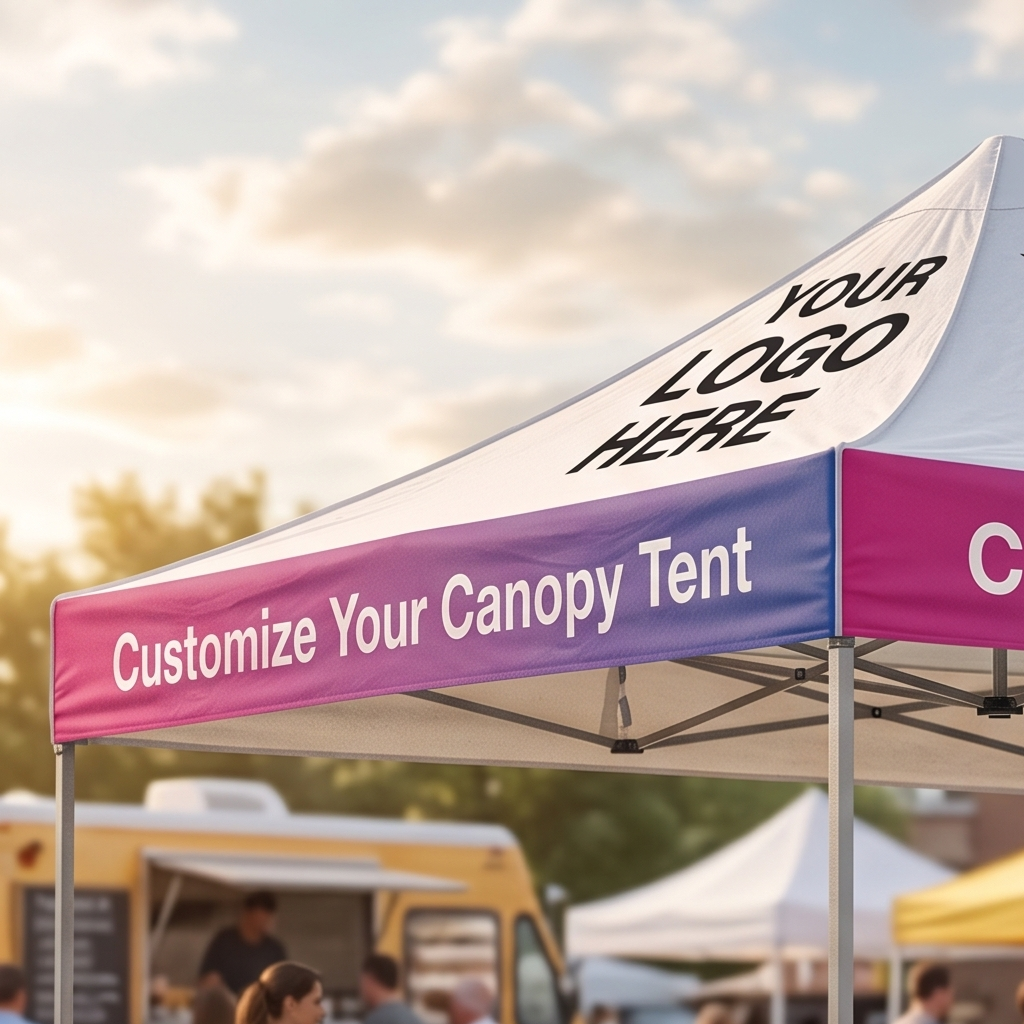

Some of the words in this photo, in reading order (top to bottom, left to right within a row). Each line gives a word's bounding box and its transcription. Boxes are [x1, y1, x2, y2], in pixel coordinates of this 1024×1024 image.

[765, 255, 948, 325] YOUR
[639, 312, 910, 407] LOGO
[565, 387, 821, 475] HERE
[112, 607, 317, 692] Customize
[329, 592, 428, 657] Your
[441, 563, 624, 640] Canopy
[638, 526, 753, 608] Tent
